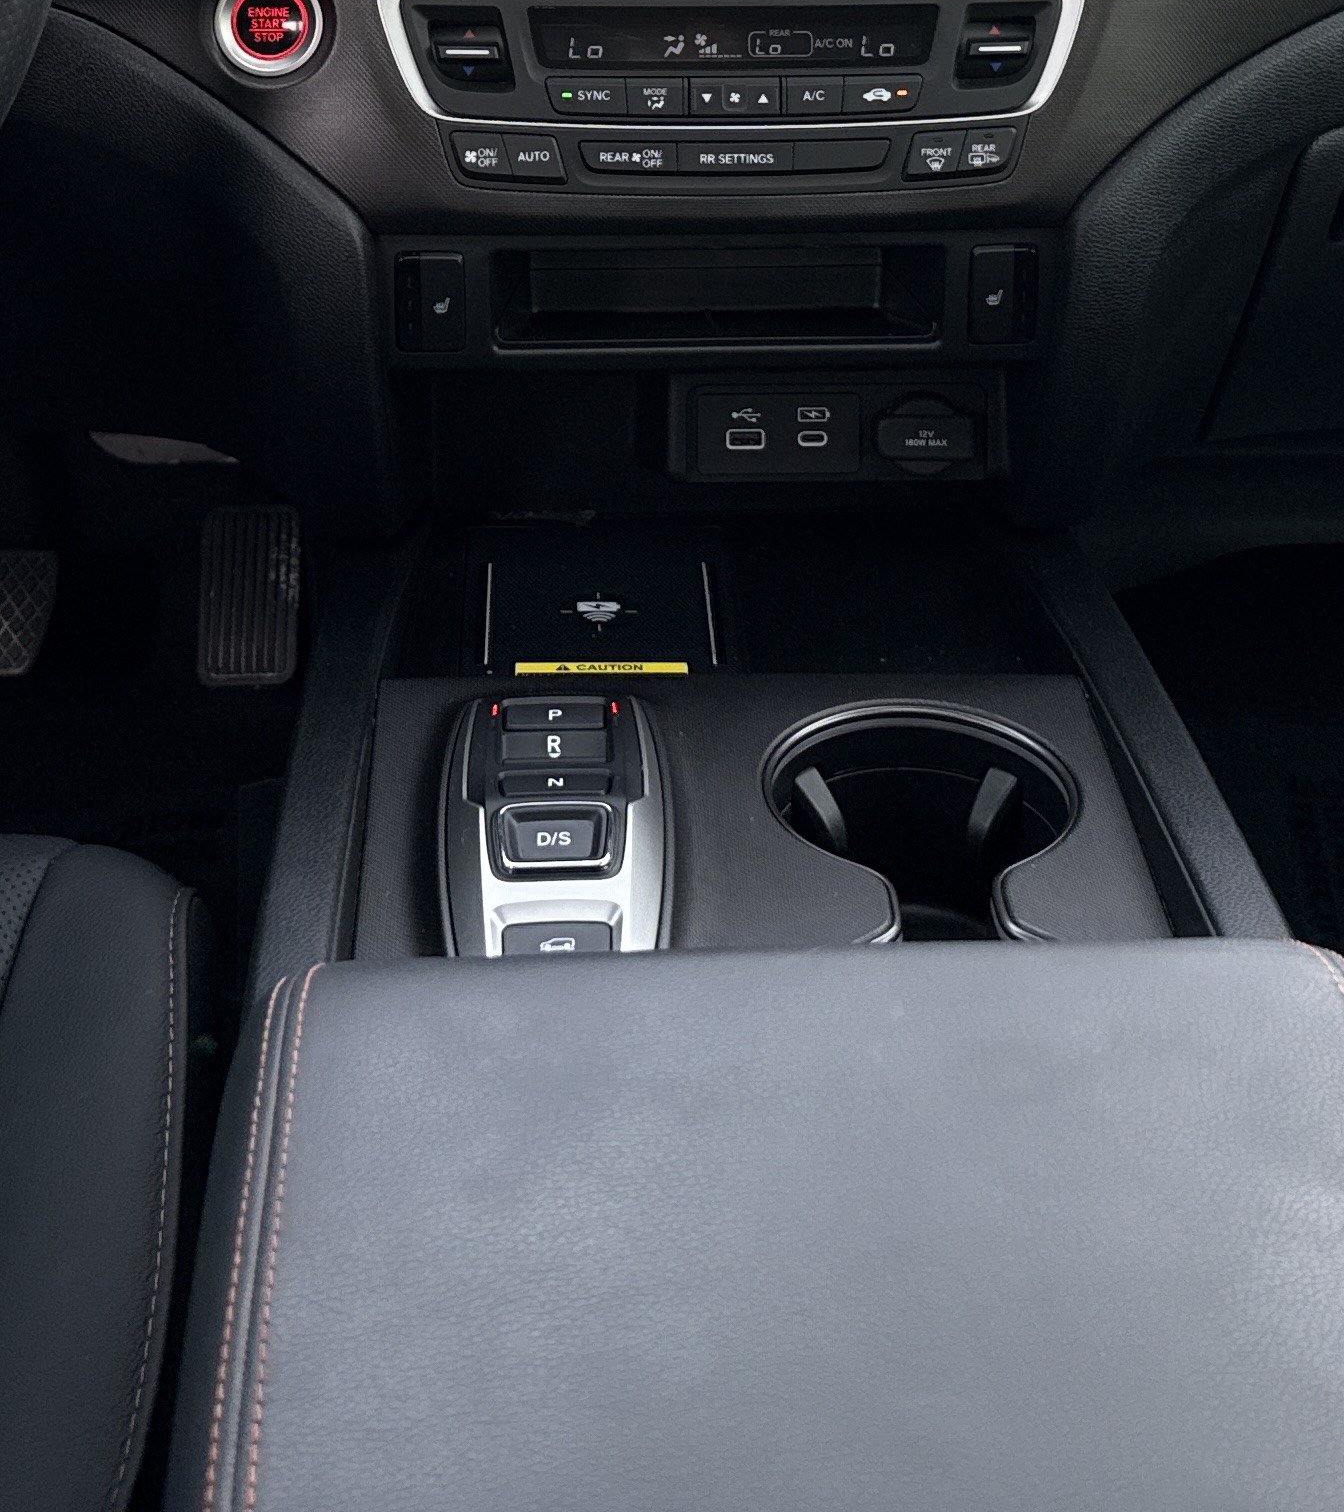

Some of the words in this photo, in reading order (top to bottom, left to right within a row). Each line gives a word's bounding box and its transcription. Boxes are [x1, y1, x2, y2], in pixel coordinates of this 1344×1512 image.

[247, 6, 290, 18] ENGINE
[250, 18, 287, 30] START
[253, 32, 285, 43] STOP
[769, 29, 791, 37] REAR
[814, 38, 834, 48] A/C
[836, 38, 853, 48] ON
[577, 90, 611, 102] SYNC
[642, 88, 668, 96] MODE
[802, 90, 826, 102] A/C
[477, 147, 498, 158] ON/
[642, 148, 663, 159] ON/
[921, 148, 953, 157] FRONT
[971, 144, 997, 153] REAR
[517, 151, 550, 162] AUTO
[599, 151, 630, 163] REAR
[699, 153, 716, 165] RR
[718, 153, 774, 165] SETTINGS
[477, 157, 499, 168] OFF
[642, 158, 663, 169] OFF
[918, 430, 935, 438] 12V
[928, 438, 948, 446] MAX
[575, 663, 644, 672] CAUTION
[548, 708, 563, 721] P
[547, 734, 562, 754] R
[547, 777, 564, 787] N
[536, 831, 572, 847] D/S
